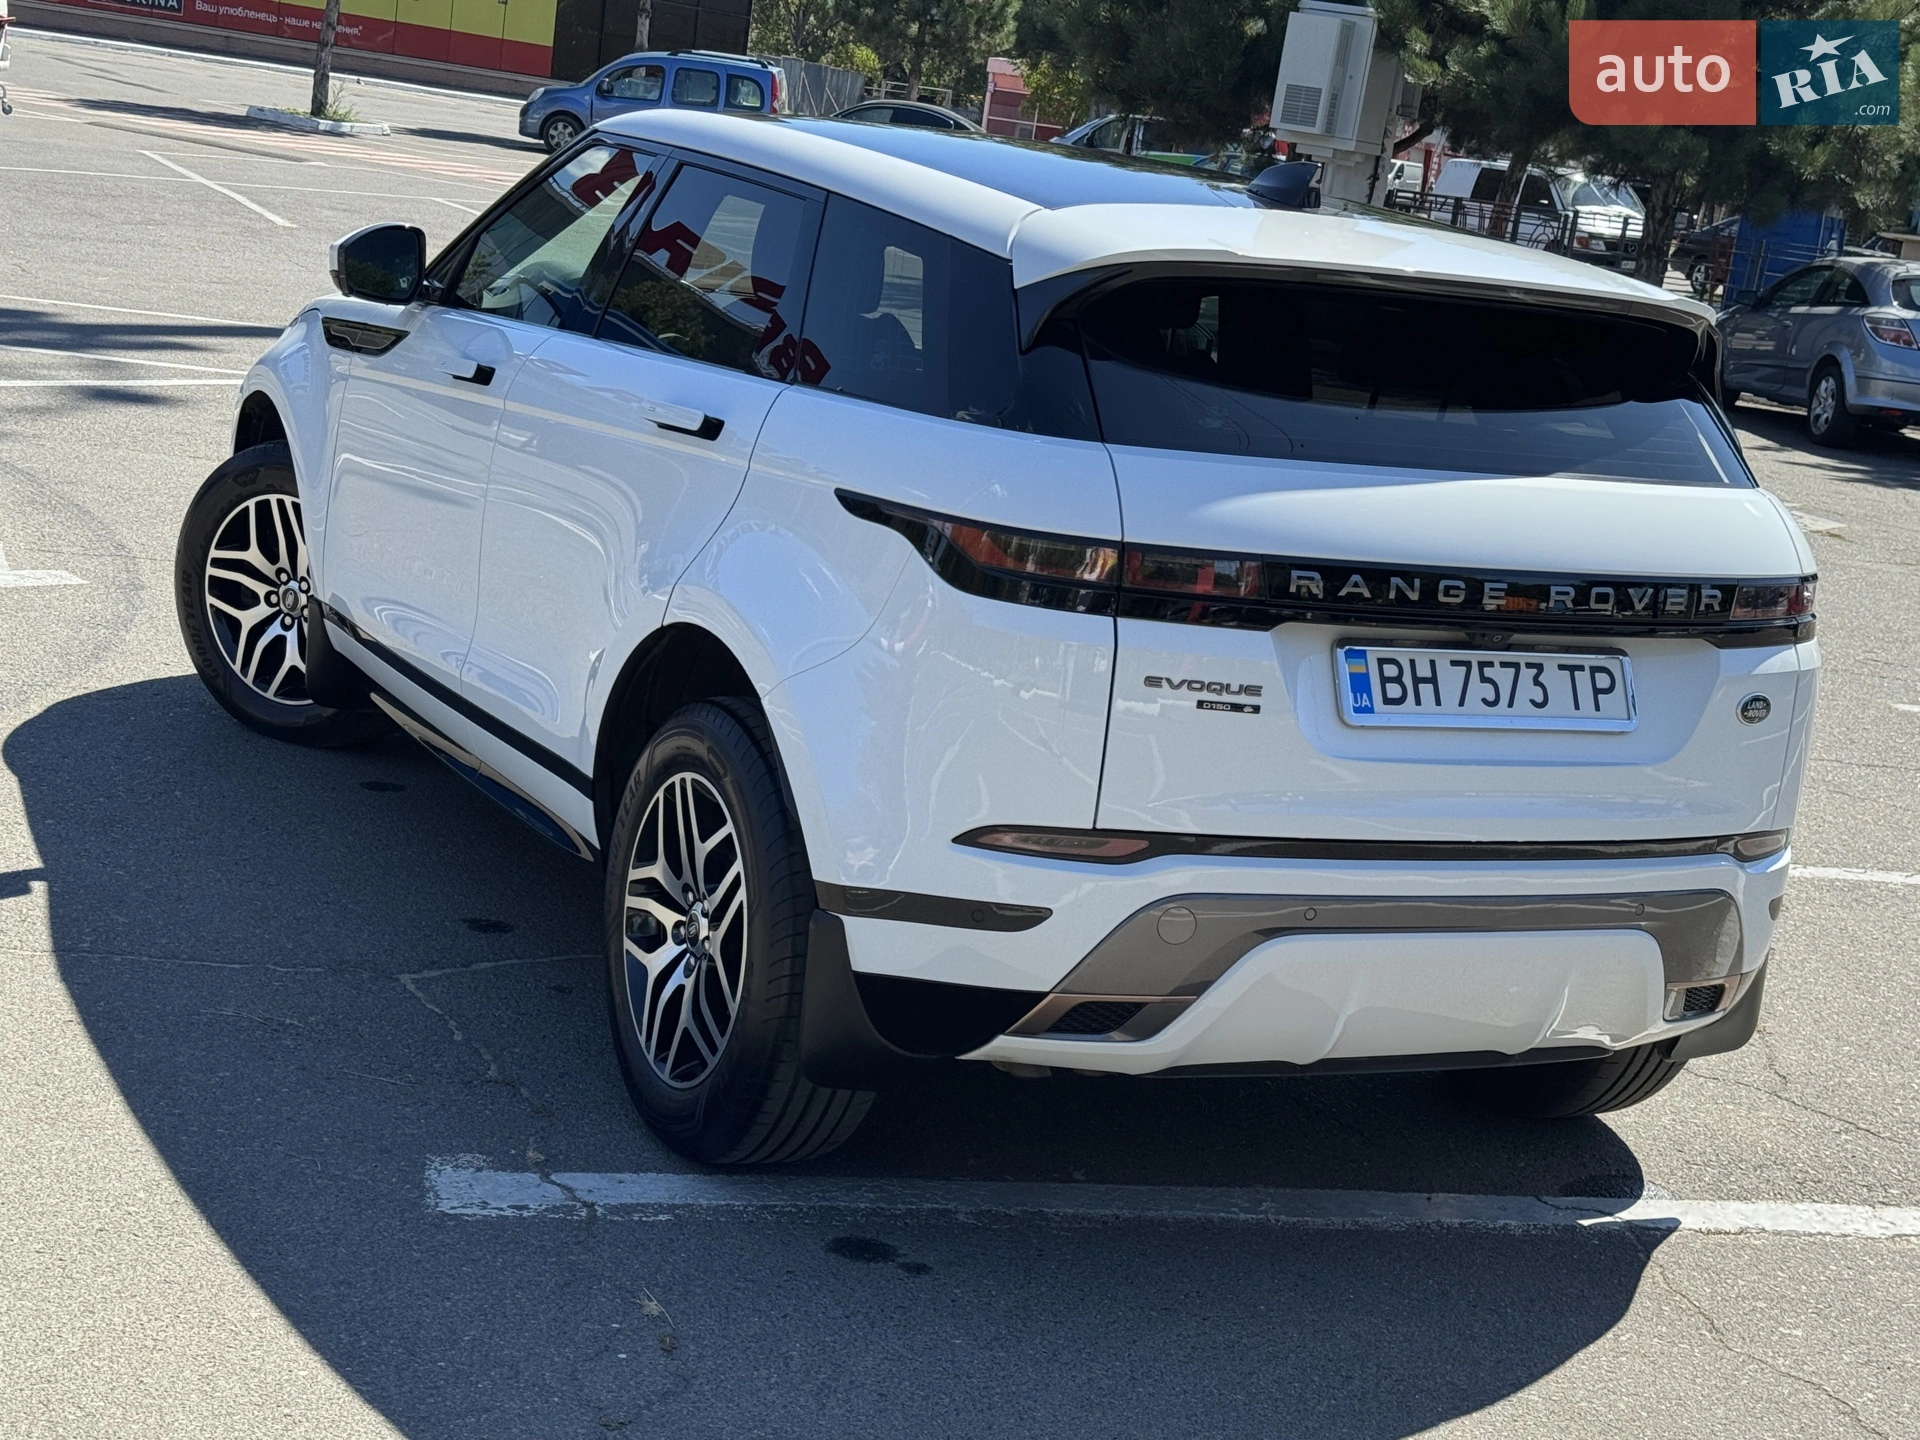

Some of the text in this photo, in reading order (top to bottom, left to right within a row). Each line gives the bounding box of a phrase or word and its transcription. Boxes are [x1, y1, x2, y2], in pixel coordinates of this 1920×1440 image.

[195, 0, 217, 13] Ваш
[218, 6, 278, 23] улюбленець
[285, 16, 311, 28] наше
[1288, 568, 1723, 612] RANGE ROVER
[1143, 675, 1264, 697] EVOQUE
[1376, 657, 1617, 712] BH 7573 TP
[1202, 702, 1232, 712] D150
[1351, 692, 1372, 709] UA
[1747, 700, 1764, 710] LAND
